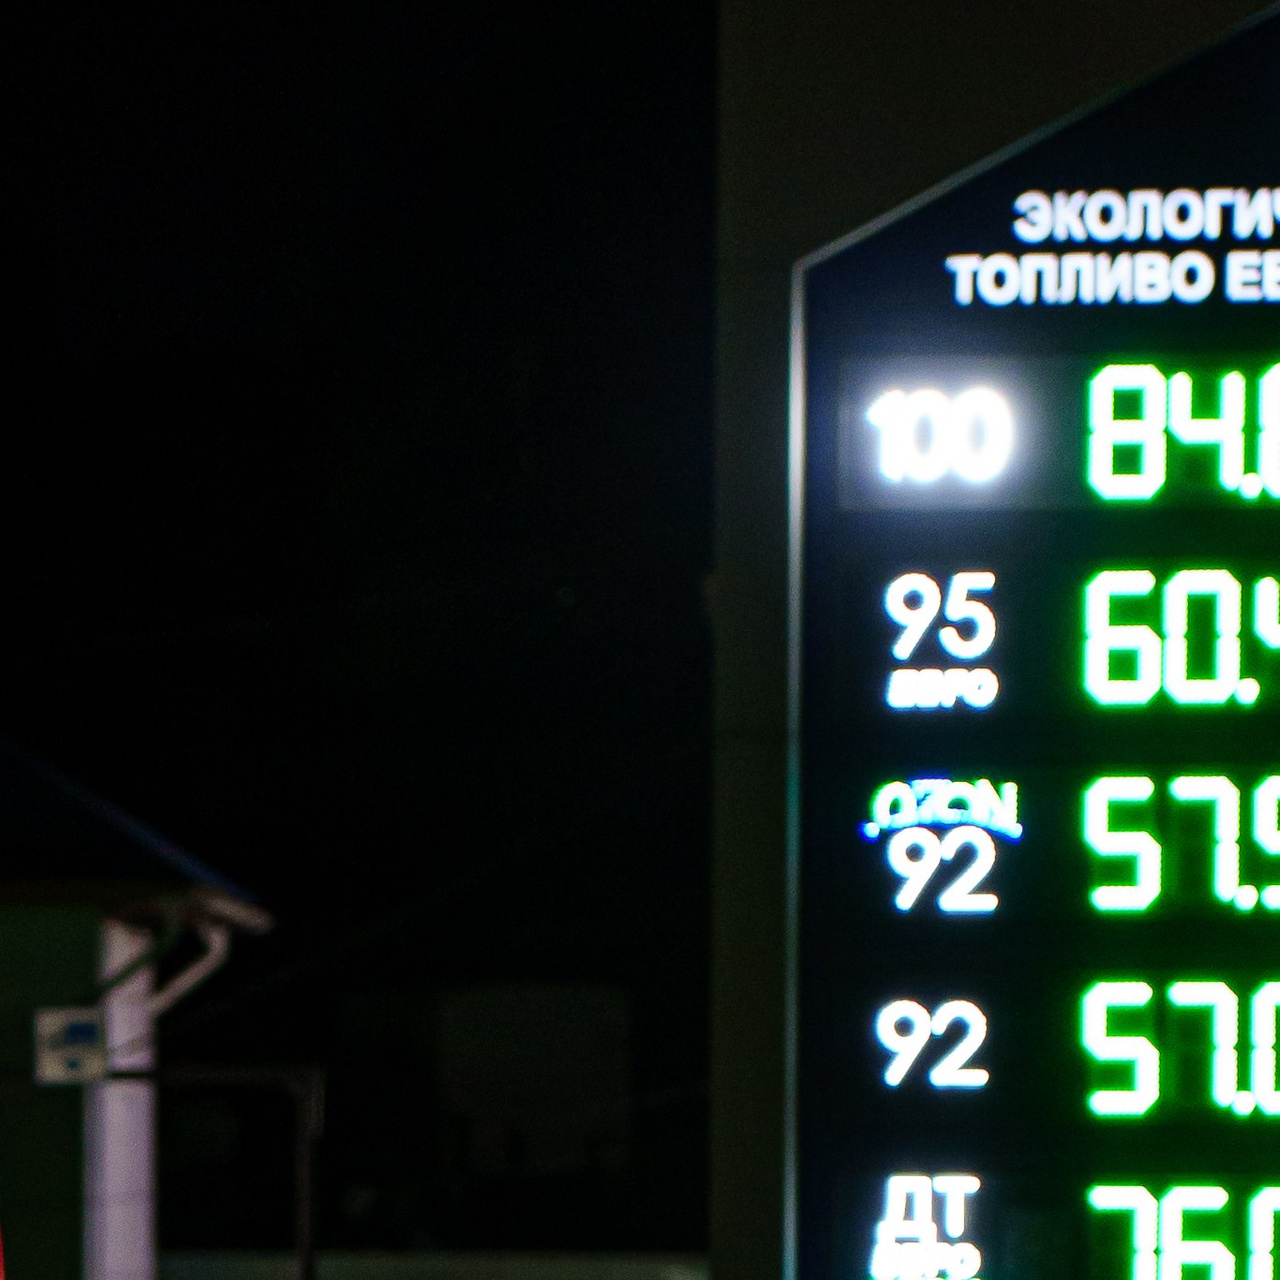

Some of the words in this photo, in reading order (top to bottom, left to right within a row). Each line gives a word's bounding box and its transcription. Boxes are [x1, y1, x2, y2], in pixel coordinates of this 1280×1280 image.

[1012, 187, 1280, 243] ЭКОЛОГИ
[944, 251, 1215, 304] ТОПЛИВО
[866, 388, 1014, 485] 100
[1086, 362, 1280, 501] 84.
[883, 572, 996, 661] 95
[885, 826, 999, 913] 92
[874, 1000, 989, 1088] 92
[876, 1175, 981, 1243] ДТ
